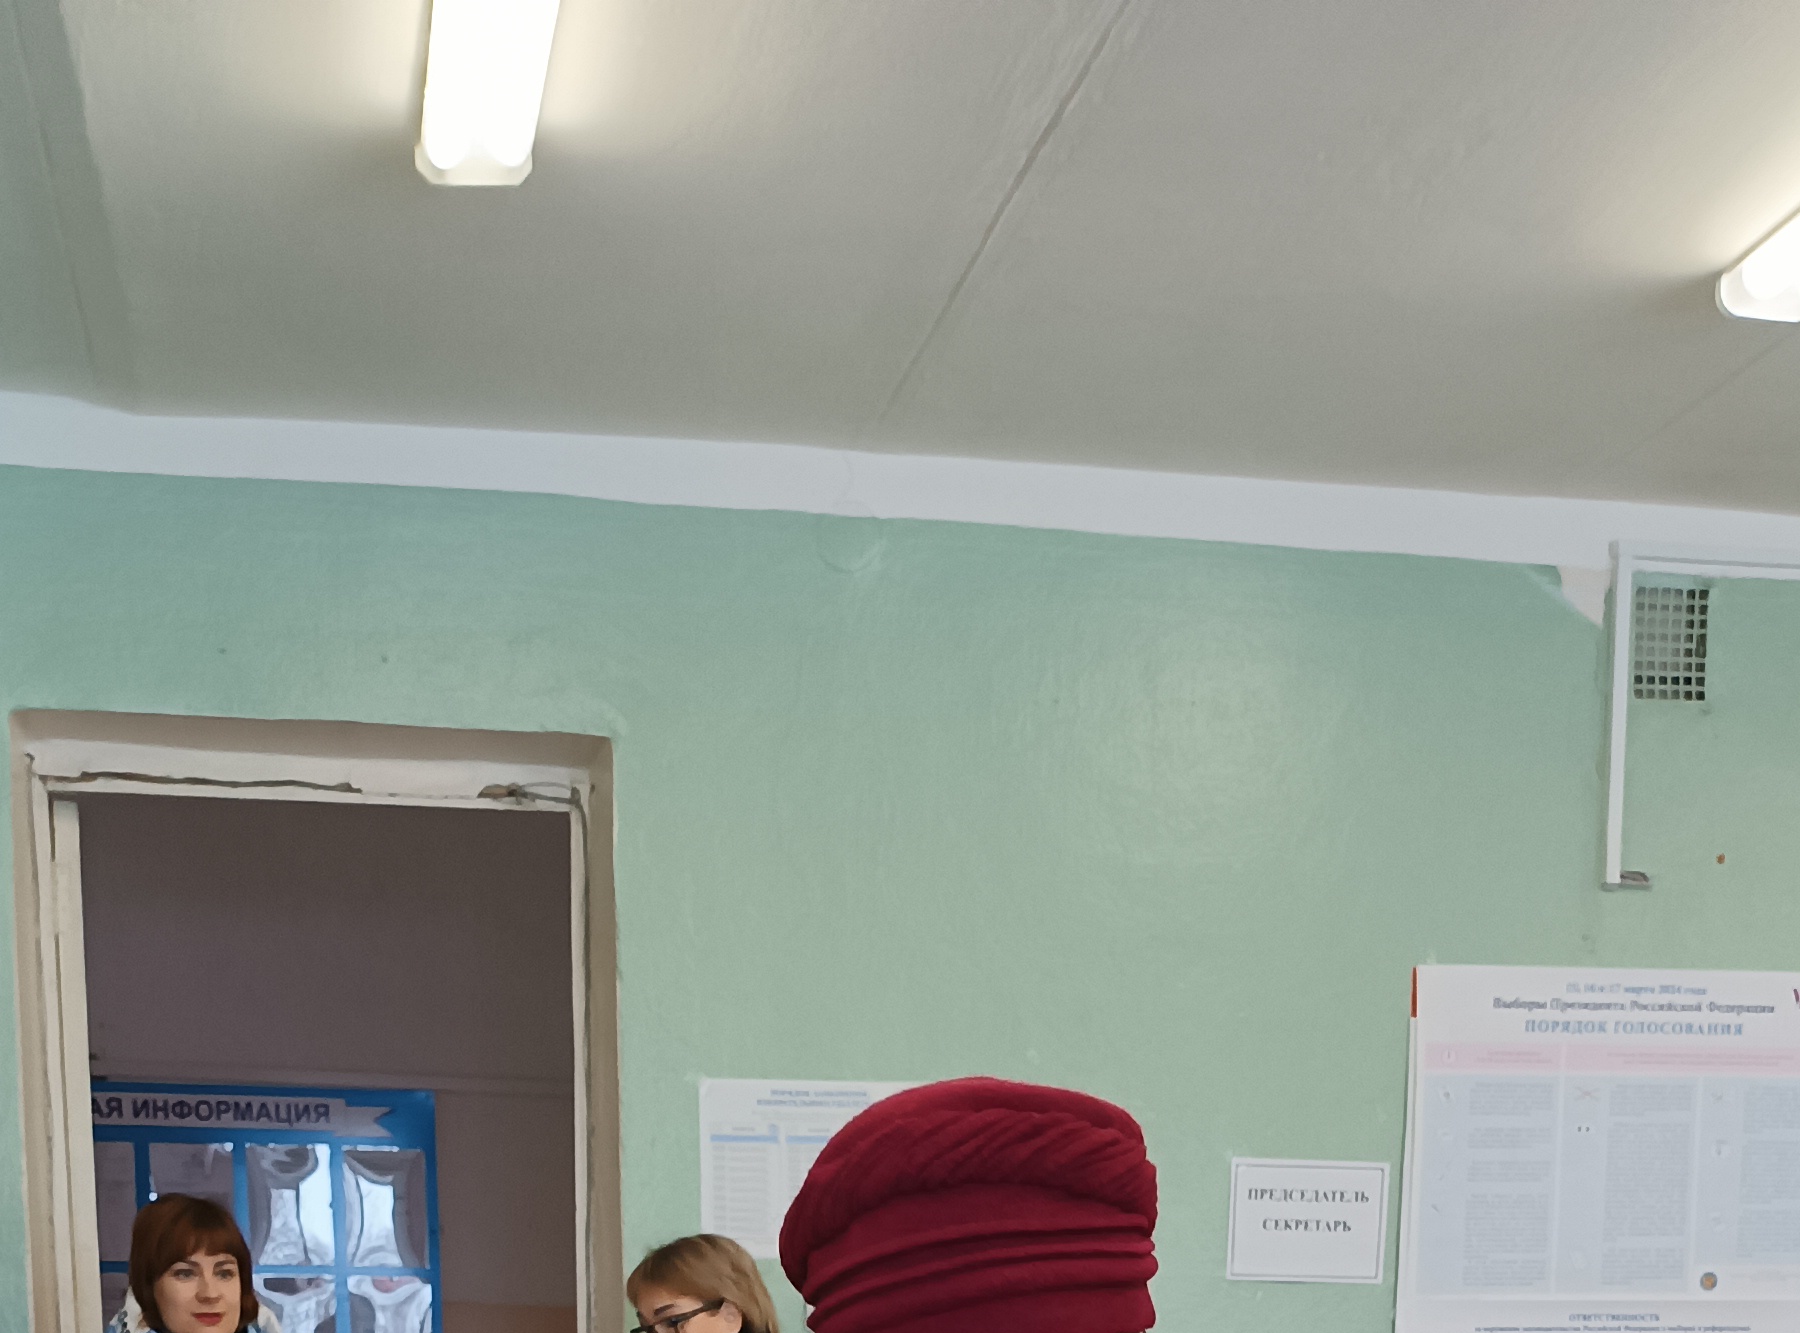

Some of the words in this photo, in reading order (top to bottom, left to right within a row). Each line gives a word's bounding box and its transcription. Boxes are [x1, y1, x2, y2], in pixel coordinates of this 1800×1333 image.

[1493, 997, 1547, 1012] Выборы
[1549, 997, 1626, 1013] Президента
[1629, 1000, 1702, 1012] Российской
[1706, 1001, 1775, 1016] Федерации
[1524, 1019, 1607, 1035] ПОРЯДОК
[1613, 1020, 1744, 1036] ГОЛОСОВАНИЯ
[132, 1098, 330, 1127] ИНФОРМАЦИЯ
[1248, 1188, 1370, 1203] ПРЕДСЕДАТЕЛЬ
[1262, 1218, 1352, 1232] СЕКРЕТАРЬ
